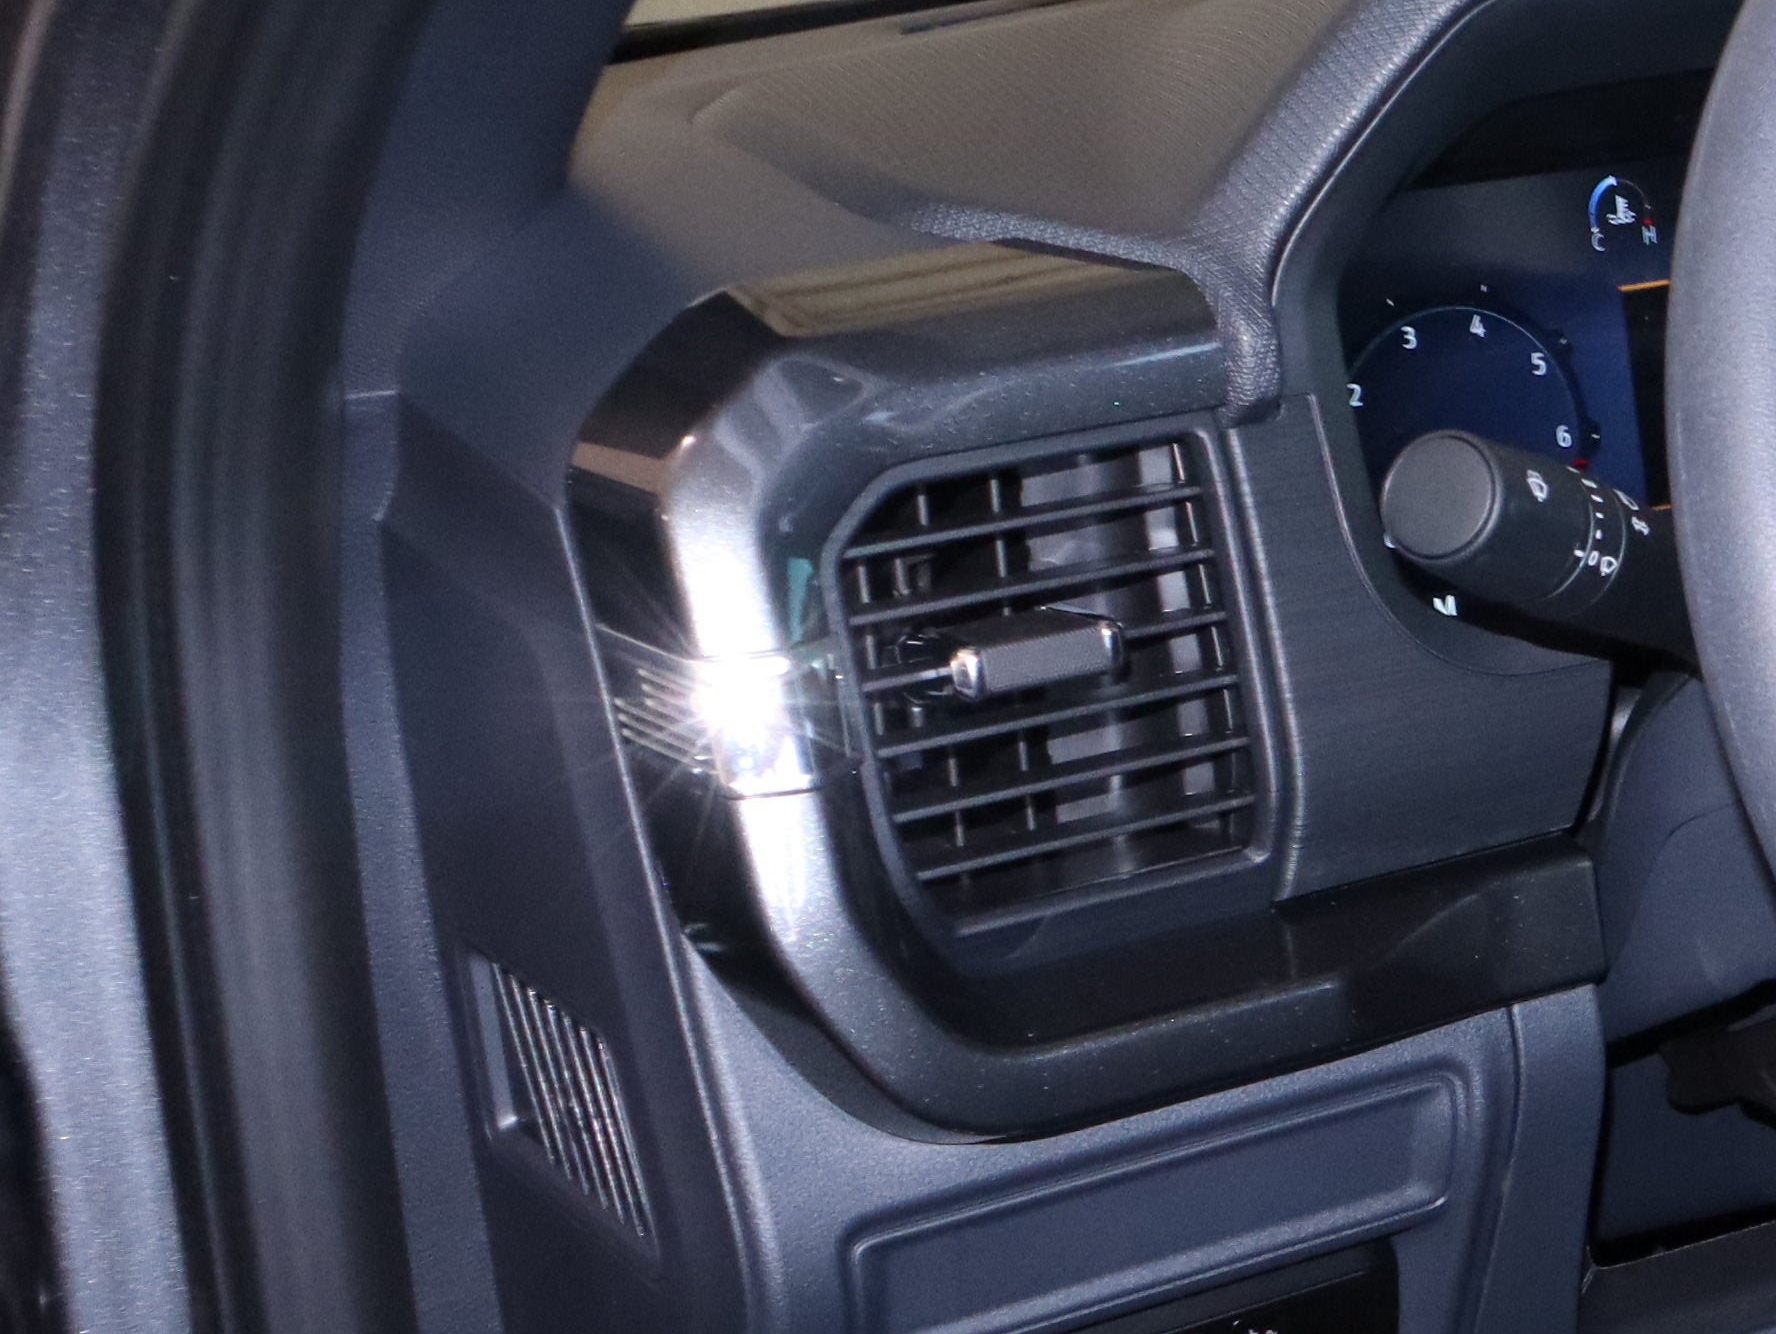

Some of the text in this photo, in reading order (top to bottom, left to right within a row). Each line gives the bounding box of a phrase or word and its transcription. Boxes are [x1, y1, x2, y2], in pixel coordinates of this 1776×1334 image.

[1401, 326, 1417, 349] 3
[1469, 314, 1486, 338] 4
[1531, 352, 1548, 376] 5
[1347, 382, 1364, 407] 2
[1555, 425, 1573, 448] 6
